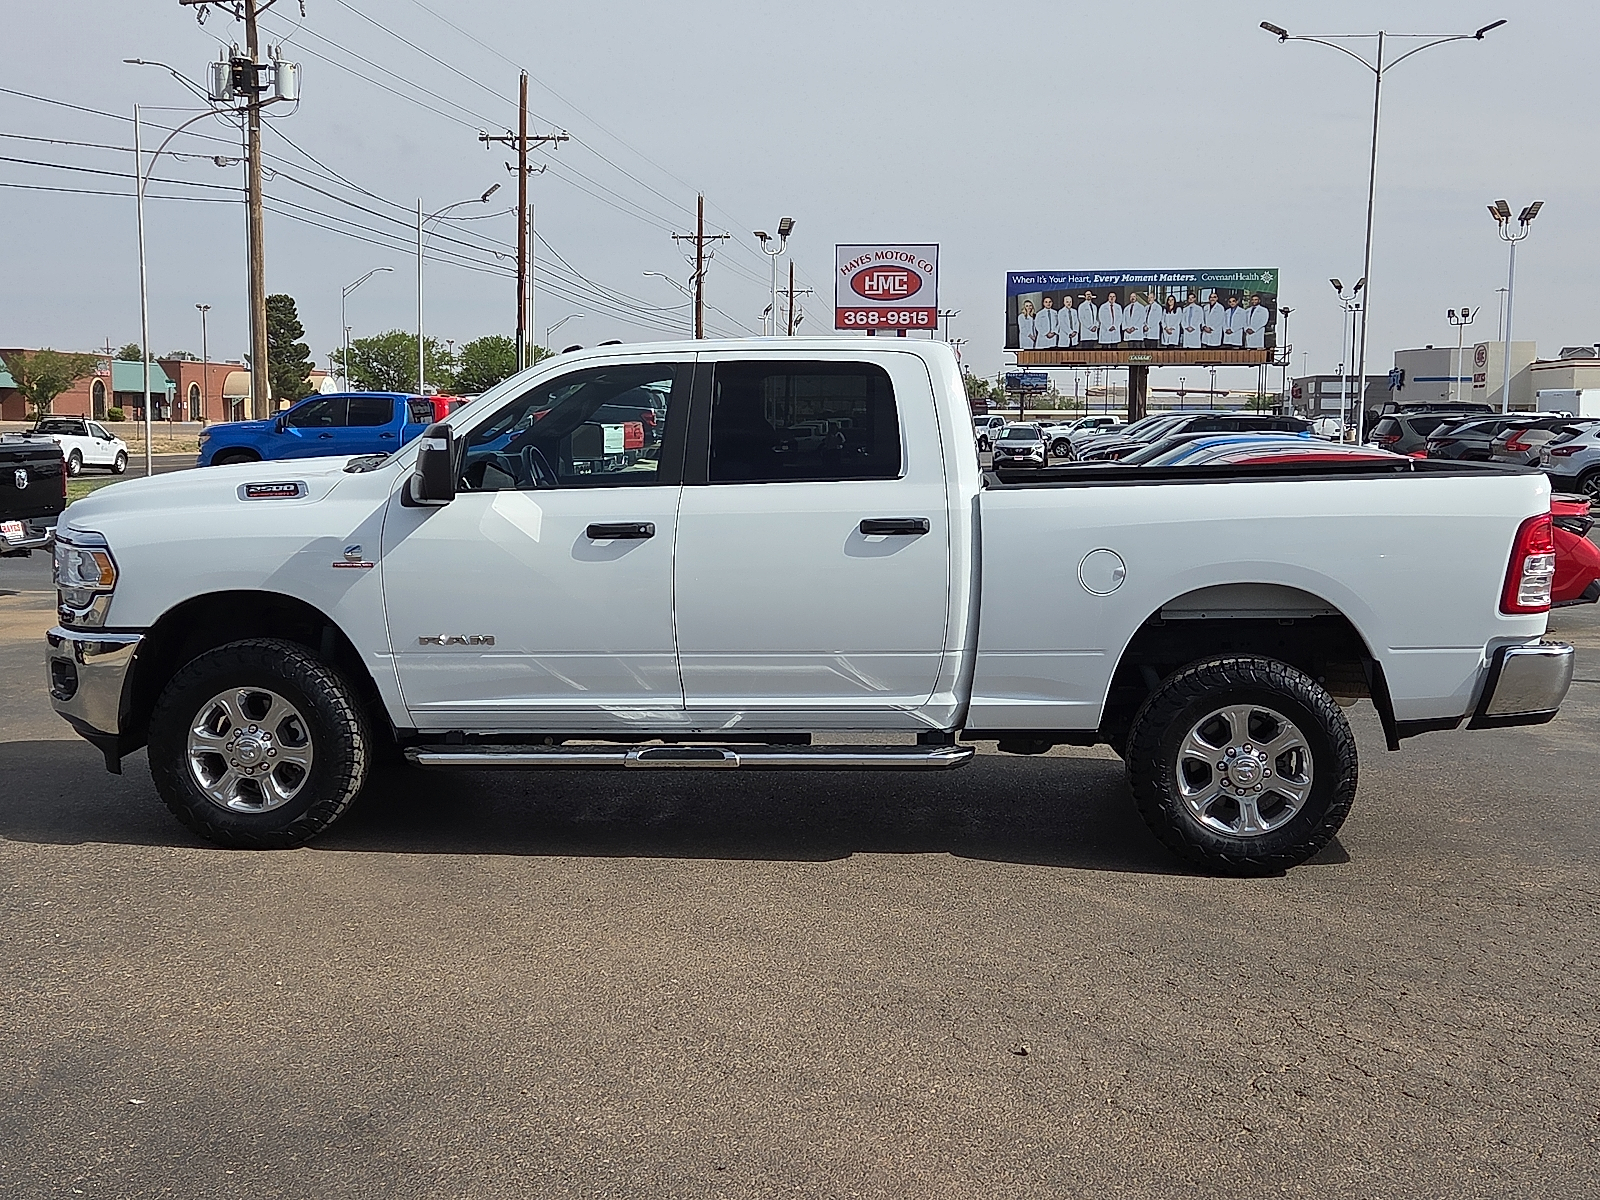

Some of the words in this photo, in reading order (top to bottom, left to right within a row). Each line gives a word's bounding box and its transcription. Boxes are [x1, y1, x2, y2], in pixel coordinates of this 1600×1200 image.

[840, 253, 872, 276] HAYES
[874, 250, 916, 264] MOTOR
[917, 259, 934, 275] CO.
[864, 271, 908, 294] HMC
[1011, 275, 1035, 284] When
[1037, 275, 1047, 284] It's
[1049, 275, 1066, 283] Your
[1068, 274, 1092, 284] Heart,
[1093, 274, 1120, 284] Every
[1121, 274, 1158, 282] Moment
[1159, 273, 1197, 282] Matters.
[843, 311, 929, 325] 368-9815
[418, 634, 496, 646] RAM
